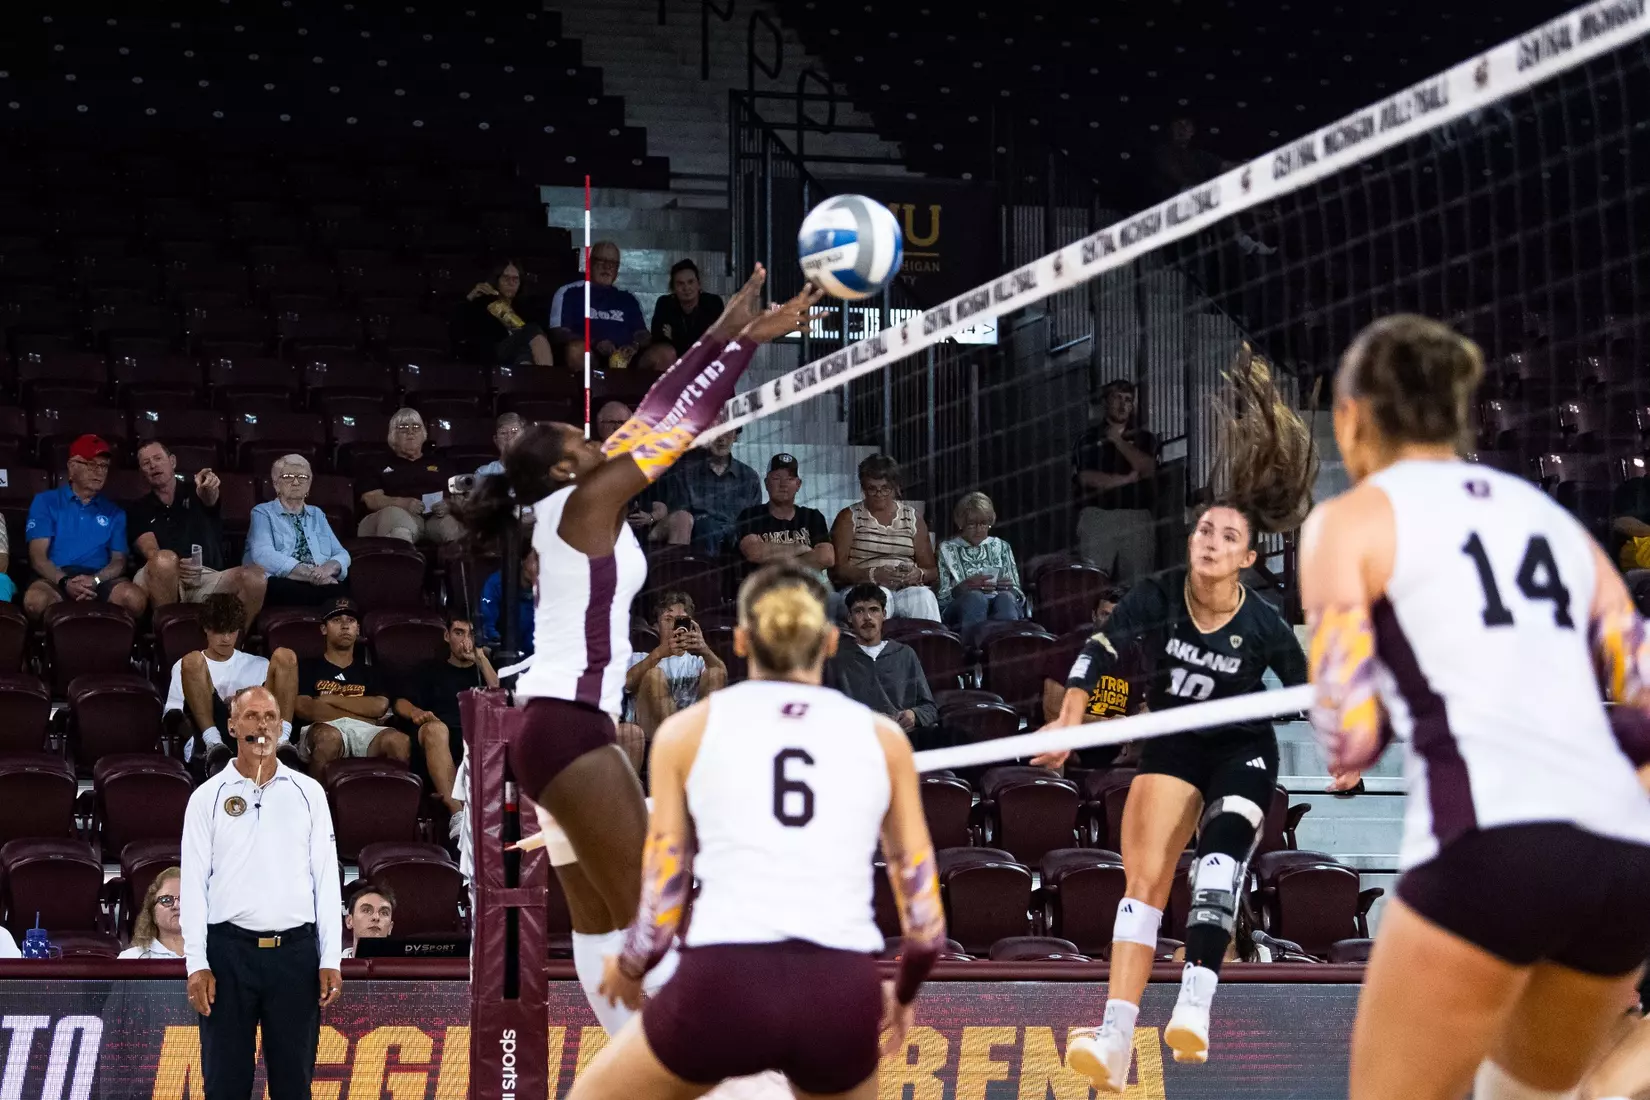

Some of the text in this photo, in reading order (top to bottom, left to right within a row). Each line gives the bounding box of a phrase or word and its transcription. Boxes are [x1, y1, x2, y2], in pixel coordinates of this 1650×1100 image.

[889, 203, 942, 247] U
[1460, 531, 1575, 630] 14
[1165, 638, 1242, 674] AKLAND
[1170, 667, 1216, 701] 10
[773, 748, 815, 827] 6
[499, 1028, 518, 1090] sports
